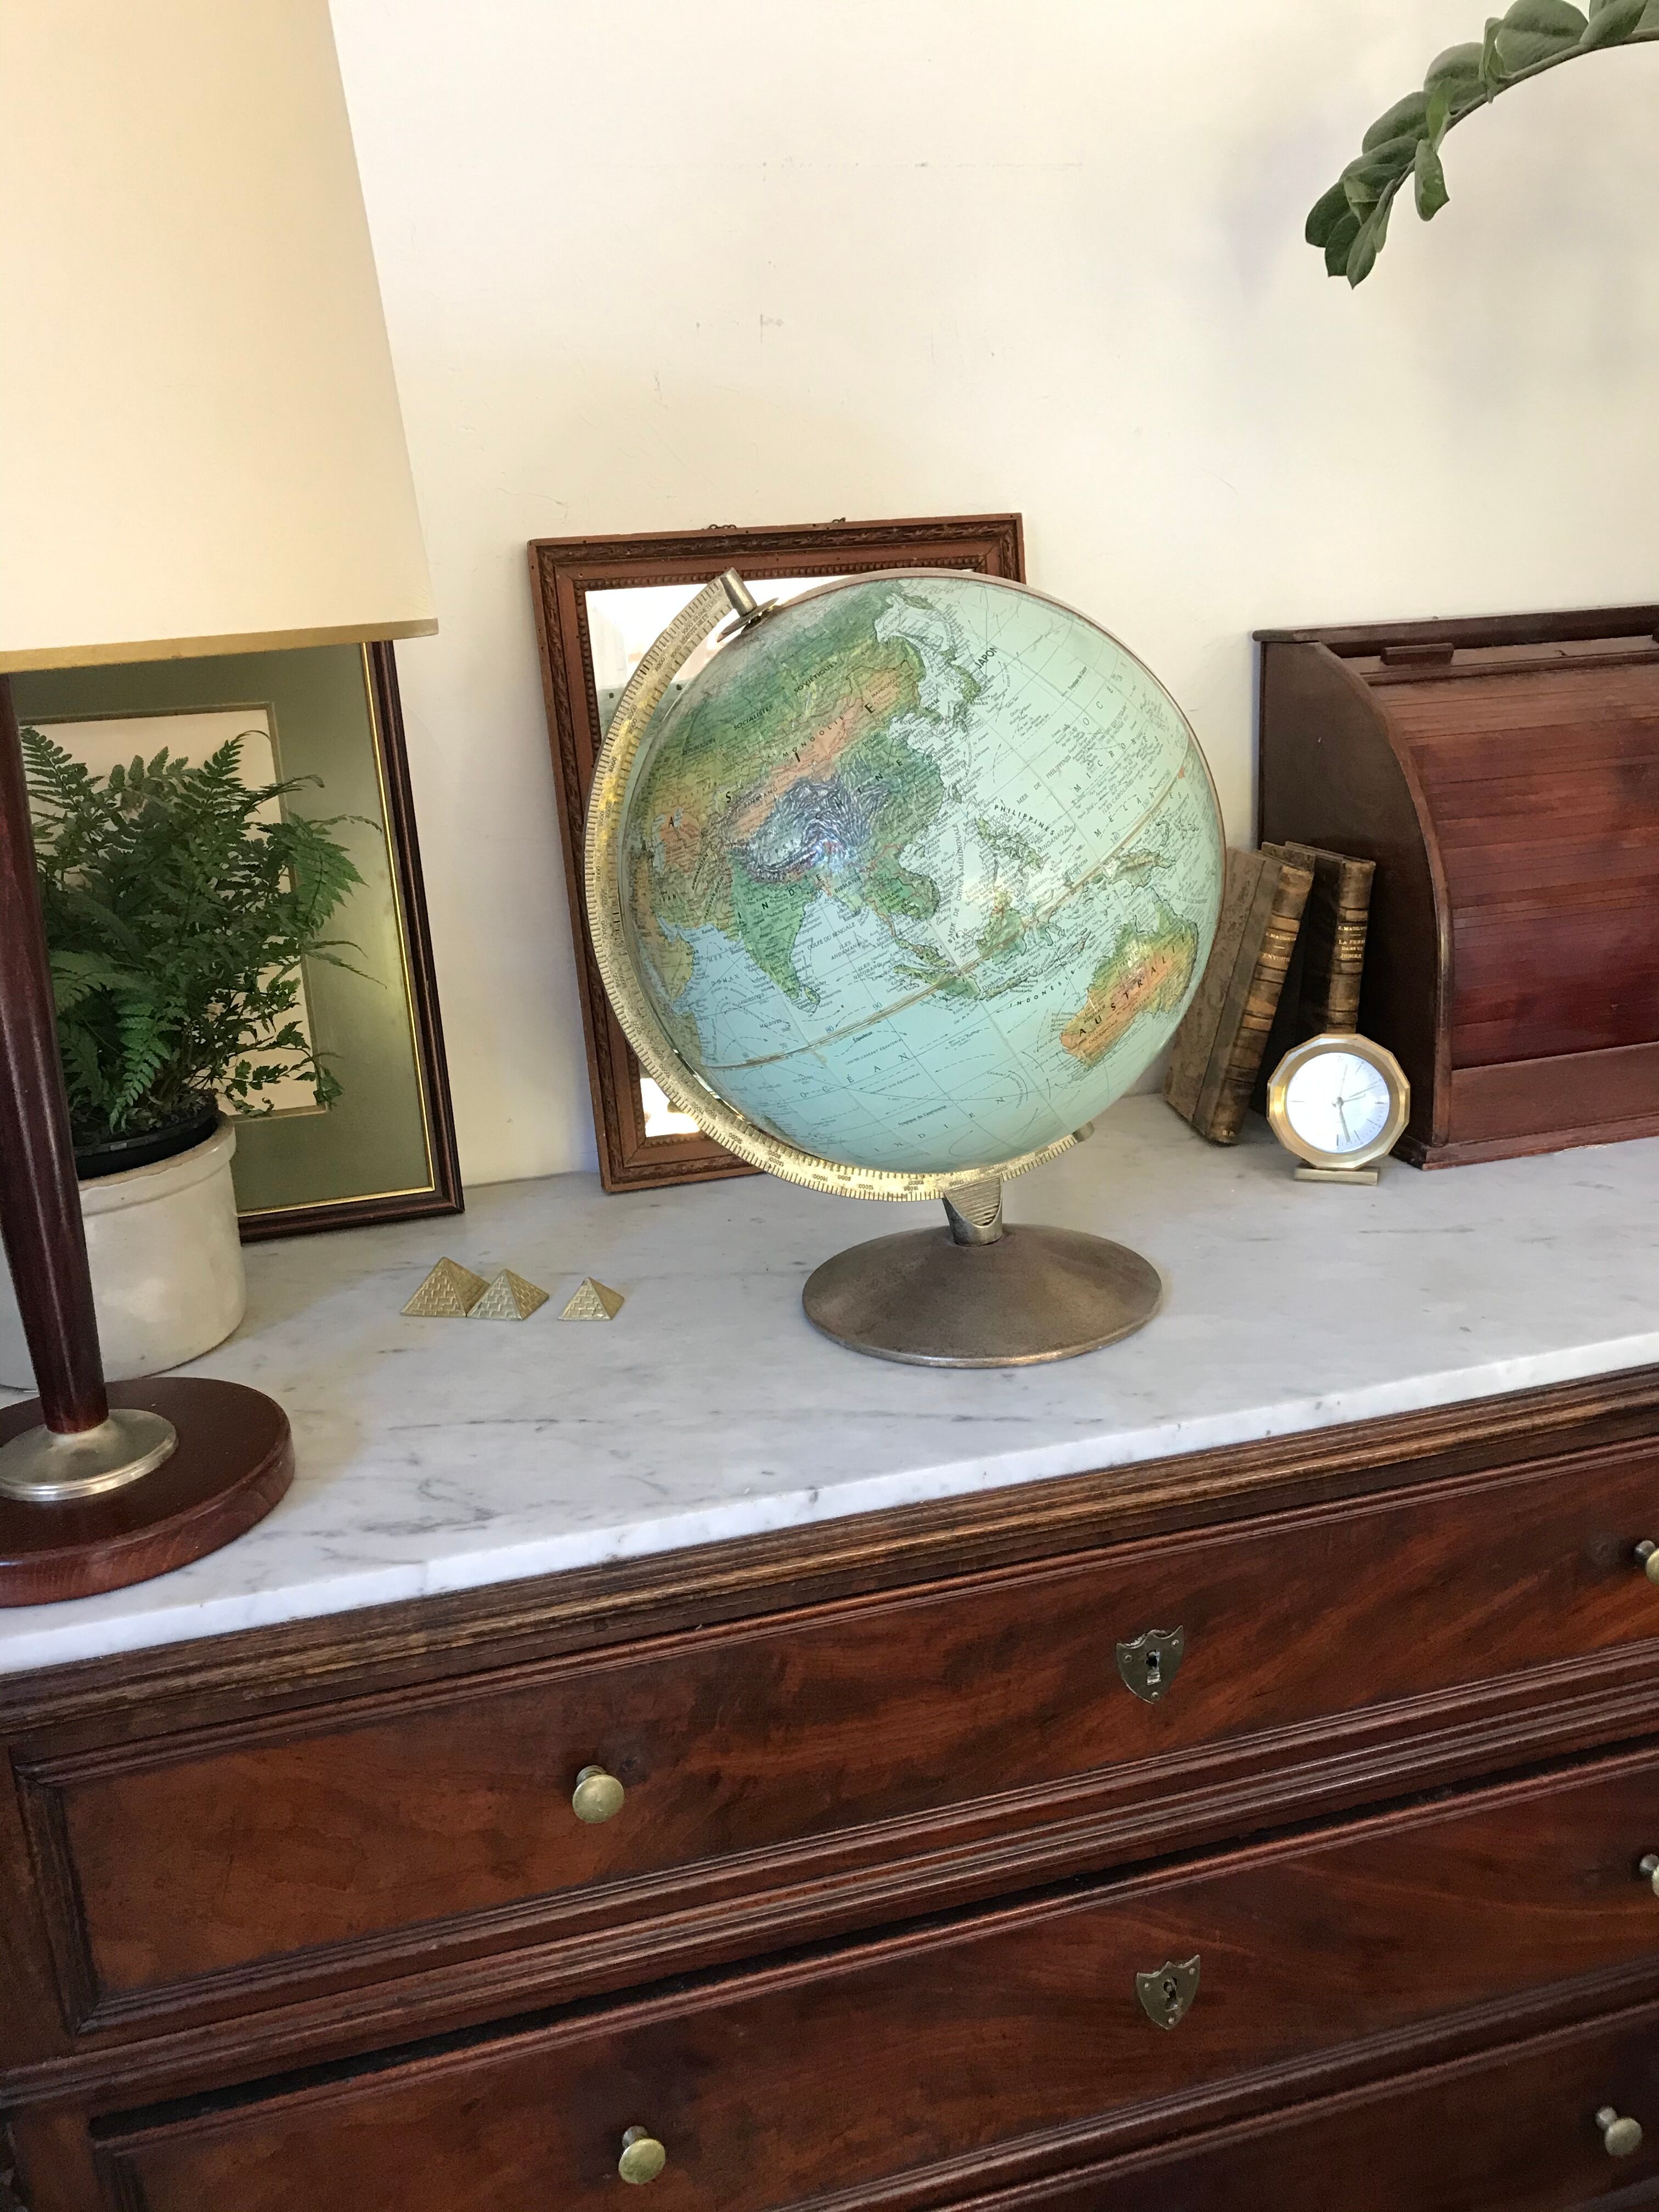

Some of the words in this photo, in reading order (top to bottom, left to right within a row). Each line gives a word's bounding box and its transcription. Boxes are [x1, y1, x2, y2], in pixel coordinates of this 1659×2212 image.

[974, 646, 999, 669] JAPON
[733, 704, 774, 731] SOCIALISTES
[782, 714, 845, 758] MONGOLIE
[913, 729, 926, 740] MER
[919, 732, 938, 747] JAUNE
[1016, 793, 1030, 806] MER
[1045, 755, 1072, 780] PHILIPPINES
[1110, 778, 1136, 804] CAROLINES
[904, 817, 924, 833] Canton
[994, 804, 1055, 836] PHILIPPINES
[1036, 830, 1065, 855] MINDANAO
[1109, 832, 1121, 844] 140
[952, 823, 964, 871] MÉRIDIONALE
[833, 875, 861, 895] BIRMANIE
[956, 872, 965, 901] CHINE
[704, 891, 716, 920] PAKISTAN
[952, 907, 960, 918] DE
[832, 921, 856, 938] BENGALE
[947, 923, 957, 938] MER
[831, 943, 859, 961] ANDAMAN
[838, 940, 852, 950] ILES
[795, 963, 811, 974] Madras
[981, 975, 1005, 991] Djakarta
[1009, 968, 1076, 1008] INDONÉSIE
[1080, 934, 1186, 1037] AUSTRALIE
[998, 991, 1009, 1000] JAVA
[872, 1001, 883, 1011] 90
[759, 1018, 782, 1029] MALDIVES
[825, 1025, 835, 1034] 80
[853, 1030, 873, 1044] Équateur
[779, 1042, 788, 1050] 70
[799, 1052, 911, 1098] OCÉAN
[923, 1104, 947, 1117] Capricorne
[874, 1097, 1006, 1153] INDIEN
